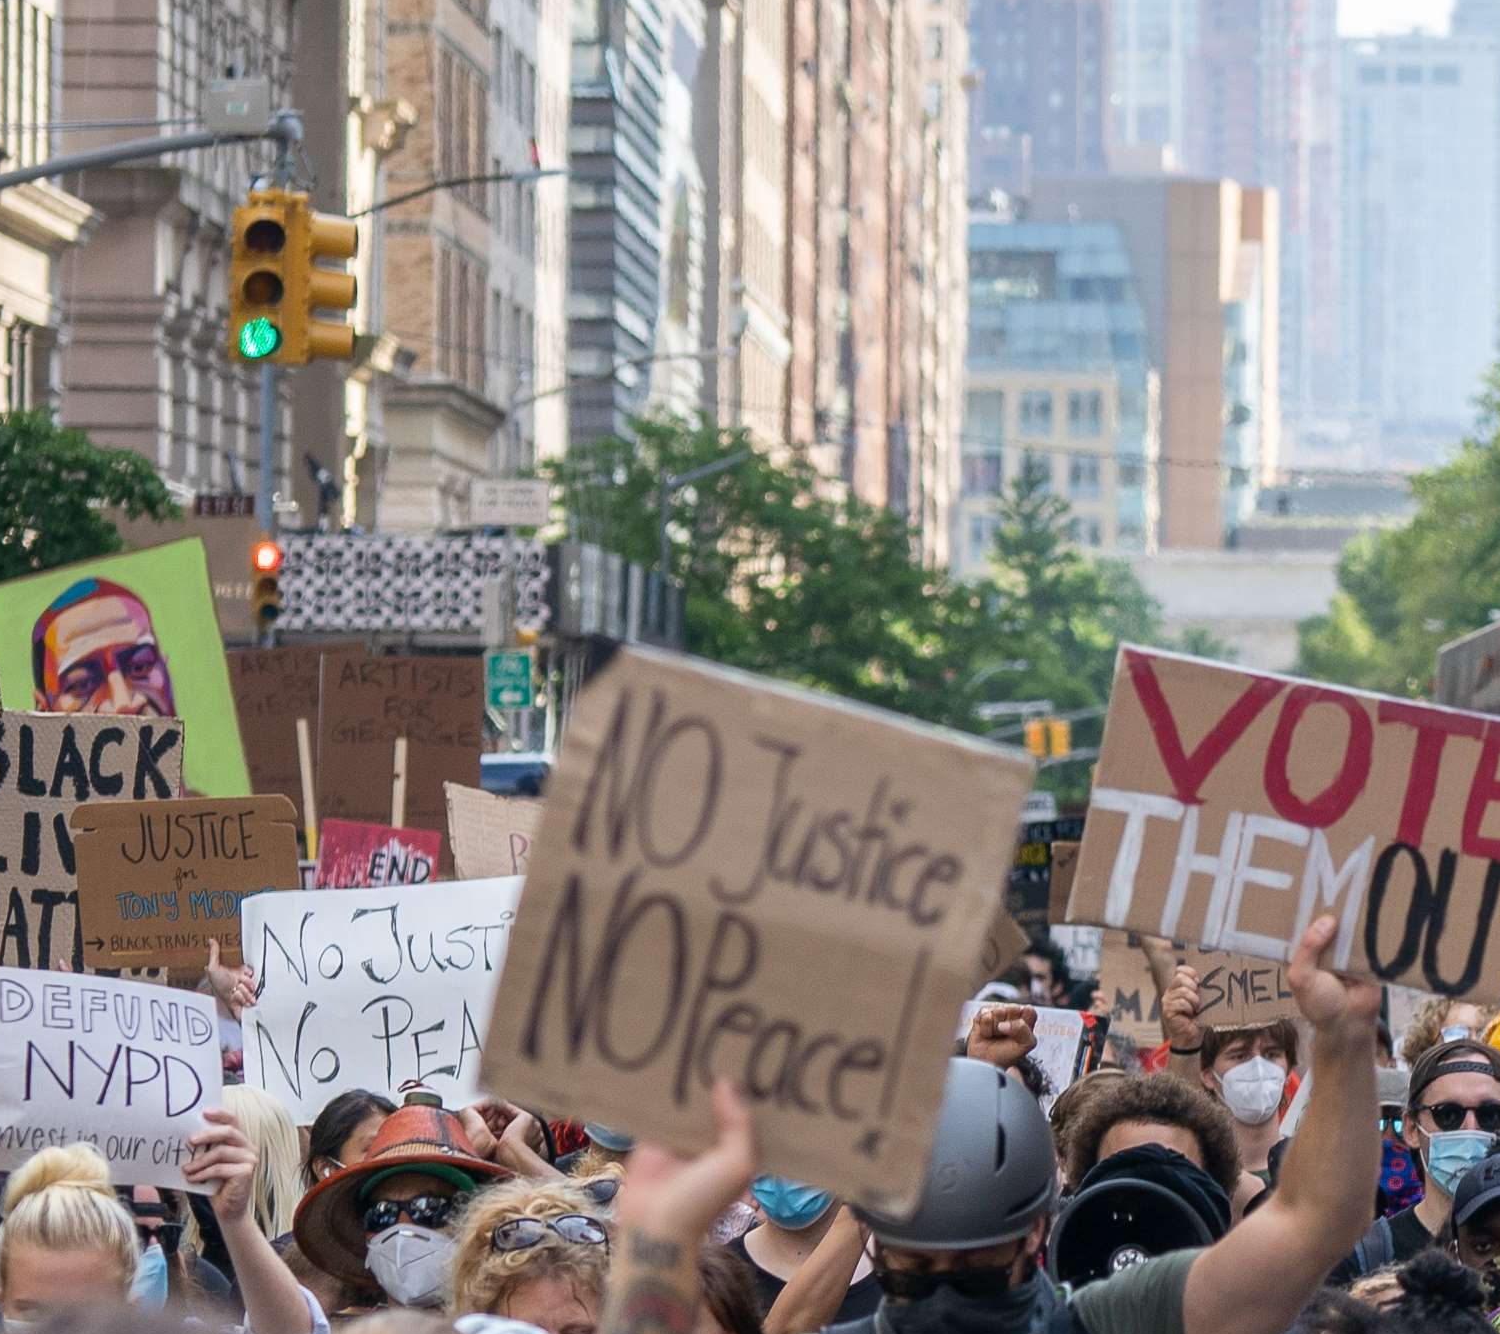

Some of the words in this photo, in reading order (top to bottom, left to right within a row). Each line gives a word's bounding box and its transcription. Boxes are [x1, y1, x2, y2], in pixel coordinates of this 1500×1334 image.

[571, 686, 723, 869] NO
[707, 731, 965, 926] Justice
[121, 811, 259, 864] JUSTICE
[173, 867, 197, 888] for
[368, 851, 430, 884] END
[1092, 788, 1374, 971] THEM
[117, 892, 179, 921] TONY
[110, 934, 154, 951] BLACK
[157, 934, 202, 951] TRANS
[521, 870, 687, 1071] NO
[1198, 967, 1295, 1014] SMEL
[0, 979, 213, 1046] DEFUND
[361, 995, 483, 1091] PEA
[24, 1041, 202, 1117] NYPD
[106, 1134, 147, 1161] our
